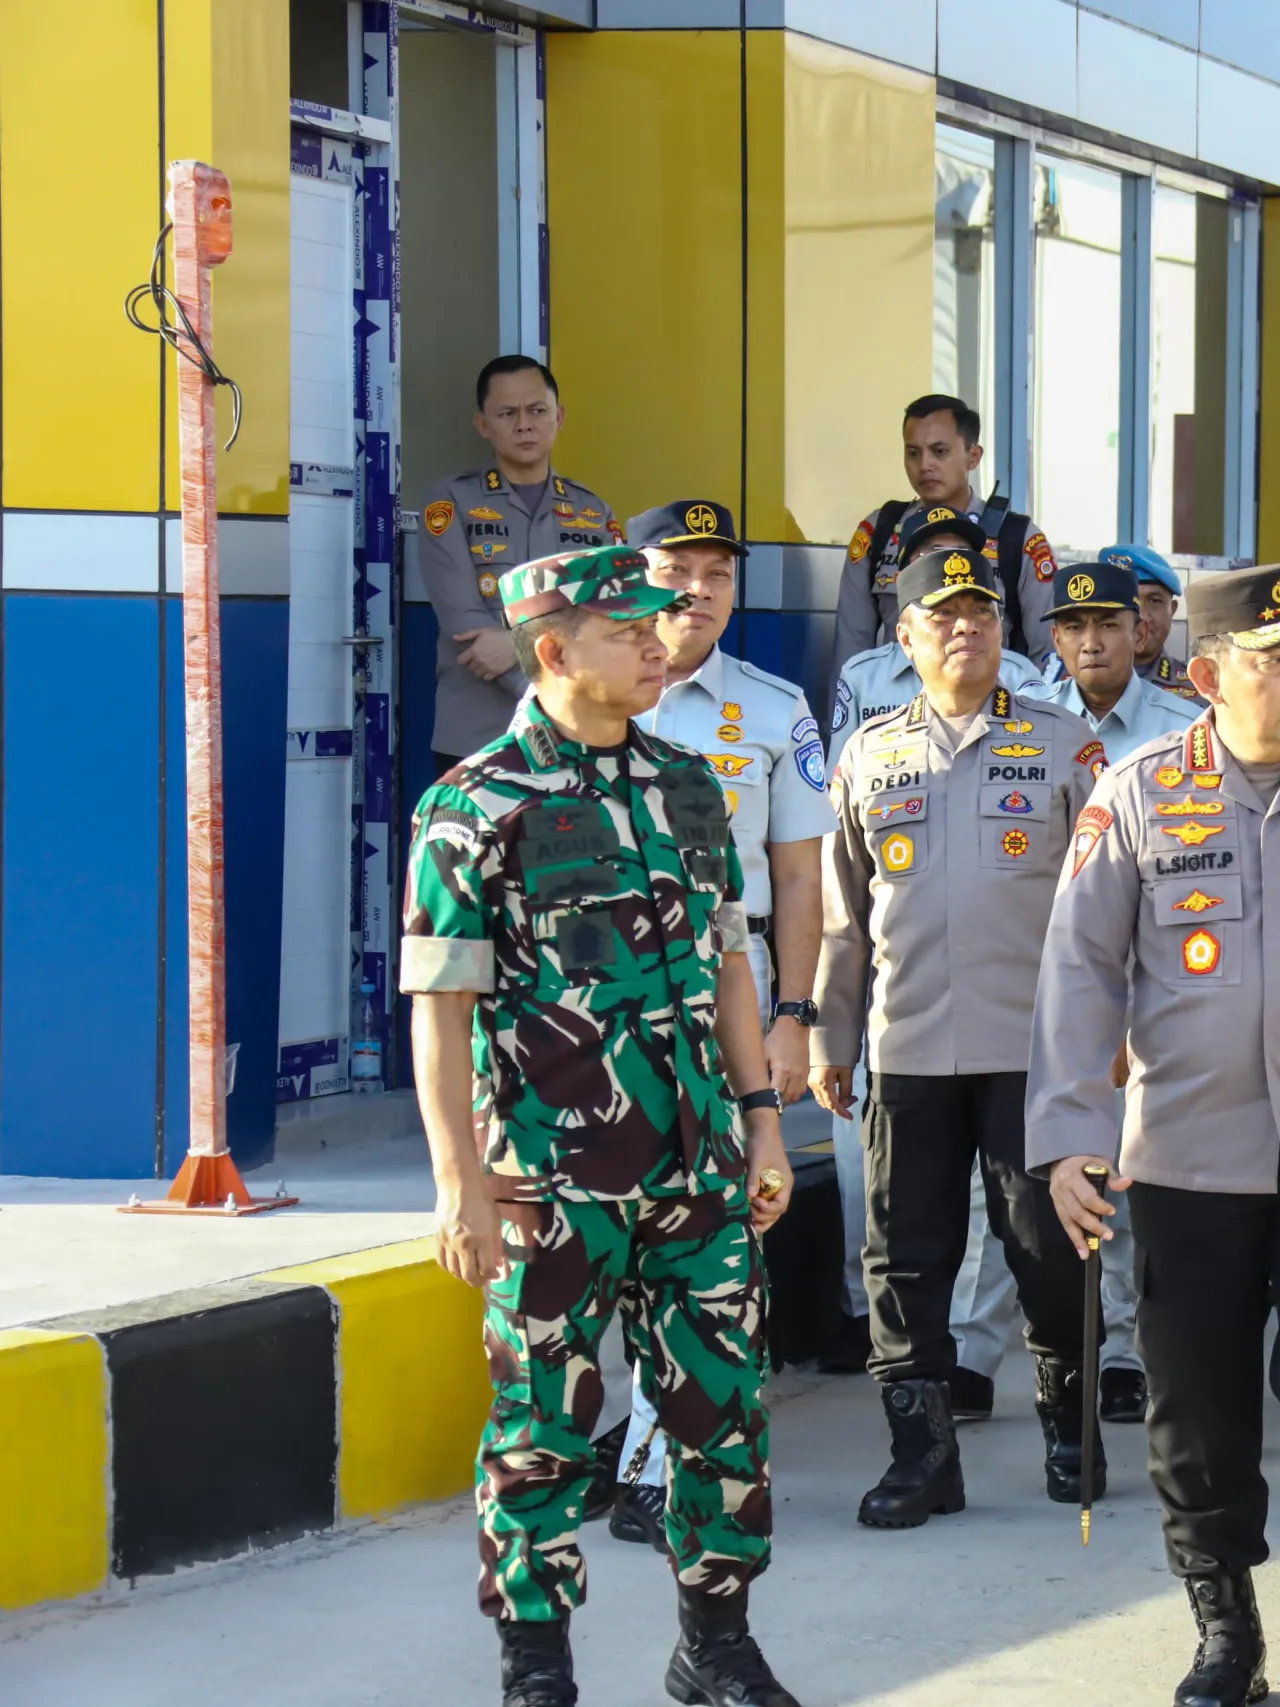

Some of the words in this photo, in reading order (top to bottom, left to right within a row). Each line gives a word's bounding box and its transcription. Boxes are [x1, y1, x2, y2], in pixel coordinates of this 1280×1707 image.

[376, 253, 385, 269] AW
[377, 516, 385, 532] AW
[467, 523, 509, 538] FERLI
[870, 770, 920, 792] DEDI
[988, 765, 1046, 781] POLRI
[375, 777, 384, 793] AW
[537, 833, 607, 861] AGUS
